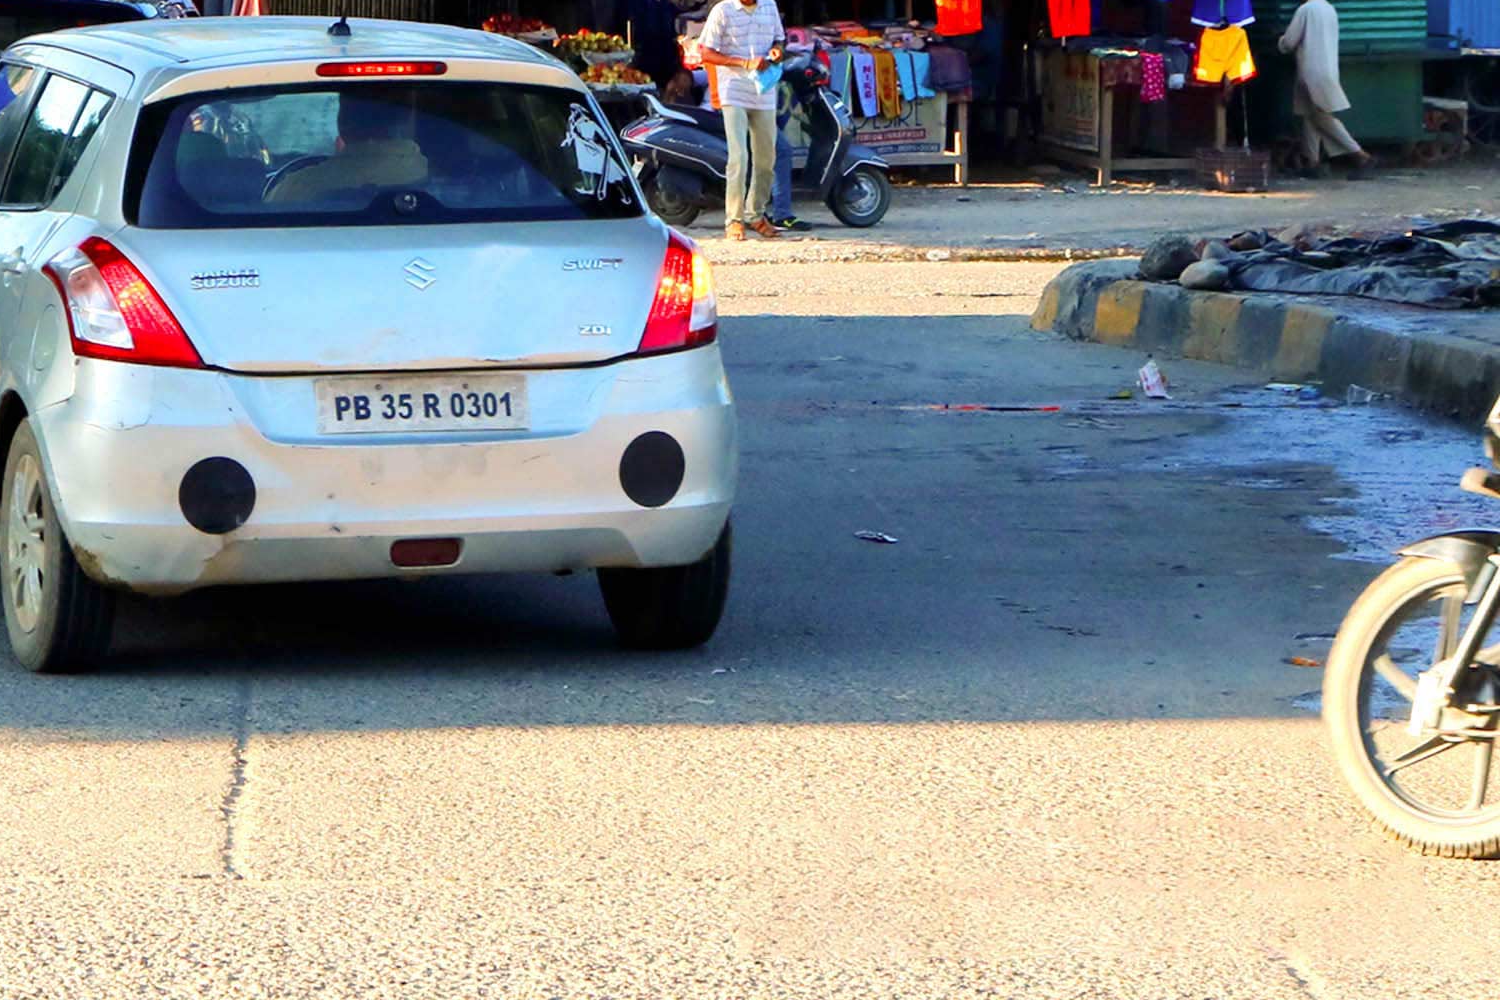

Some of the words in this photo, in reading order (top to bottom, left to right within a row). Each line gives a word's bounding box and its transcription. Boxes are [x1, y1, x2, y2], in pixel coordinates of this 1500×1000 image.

[563, 258, 623, 271] SWIFT
[190, 277, 260, 289] SUZUKI
[335, 395, 371, 420] PB
[381, 394, 413, 419] 35
[423, 393, 442, 418] R
[450, 392, 512, 418] 0301
